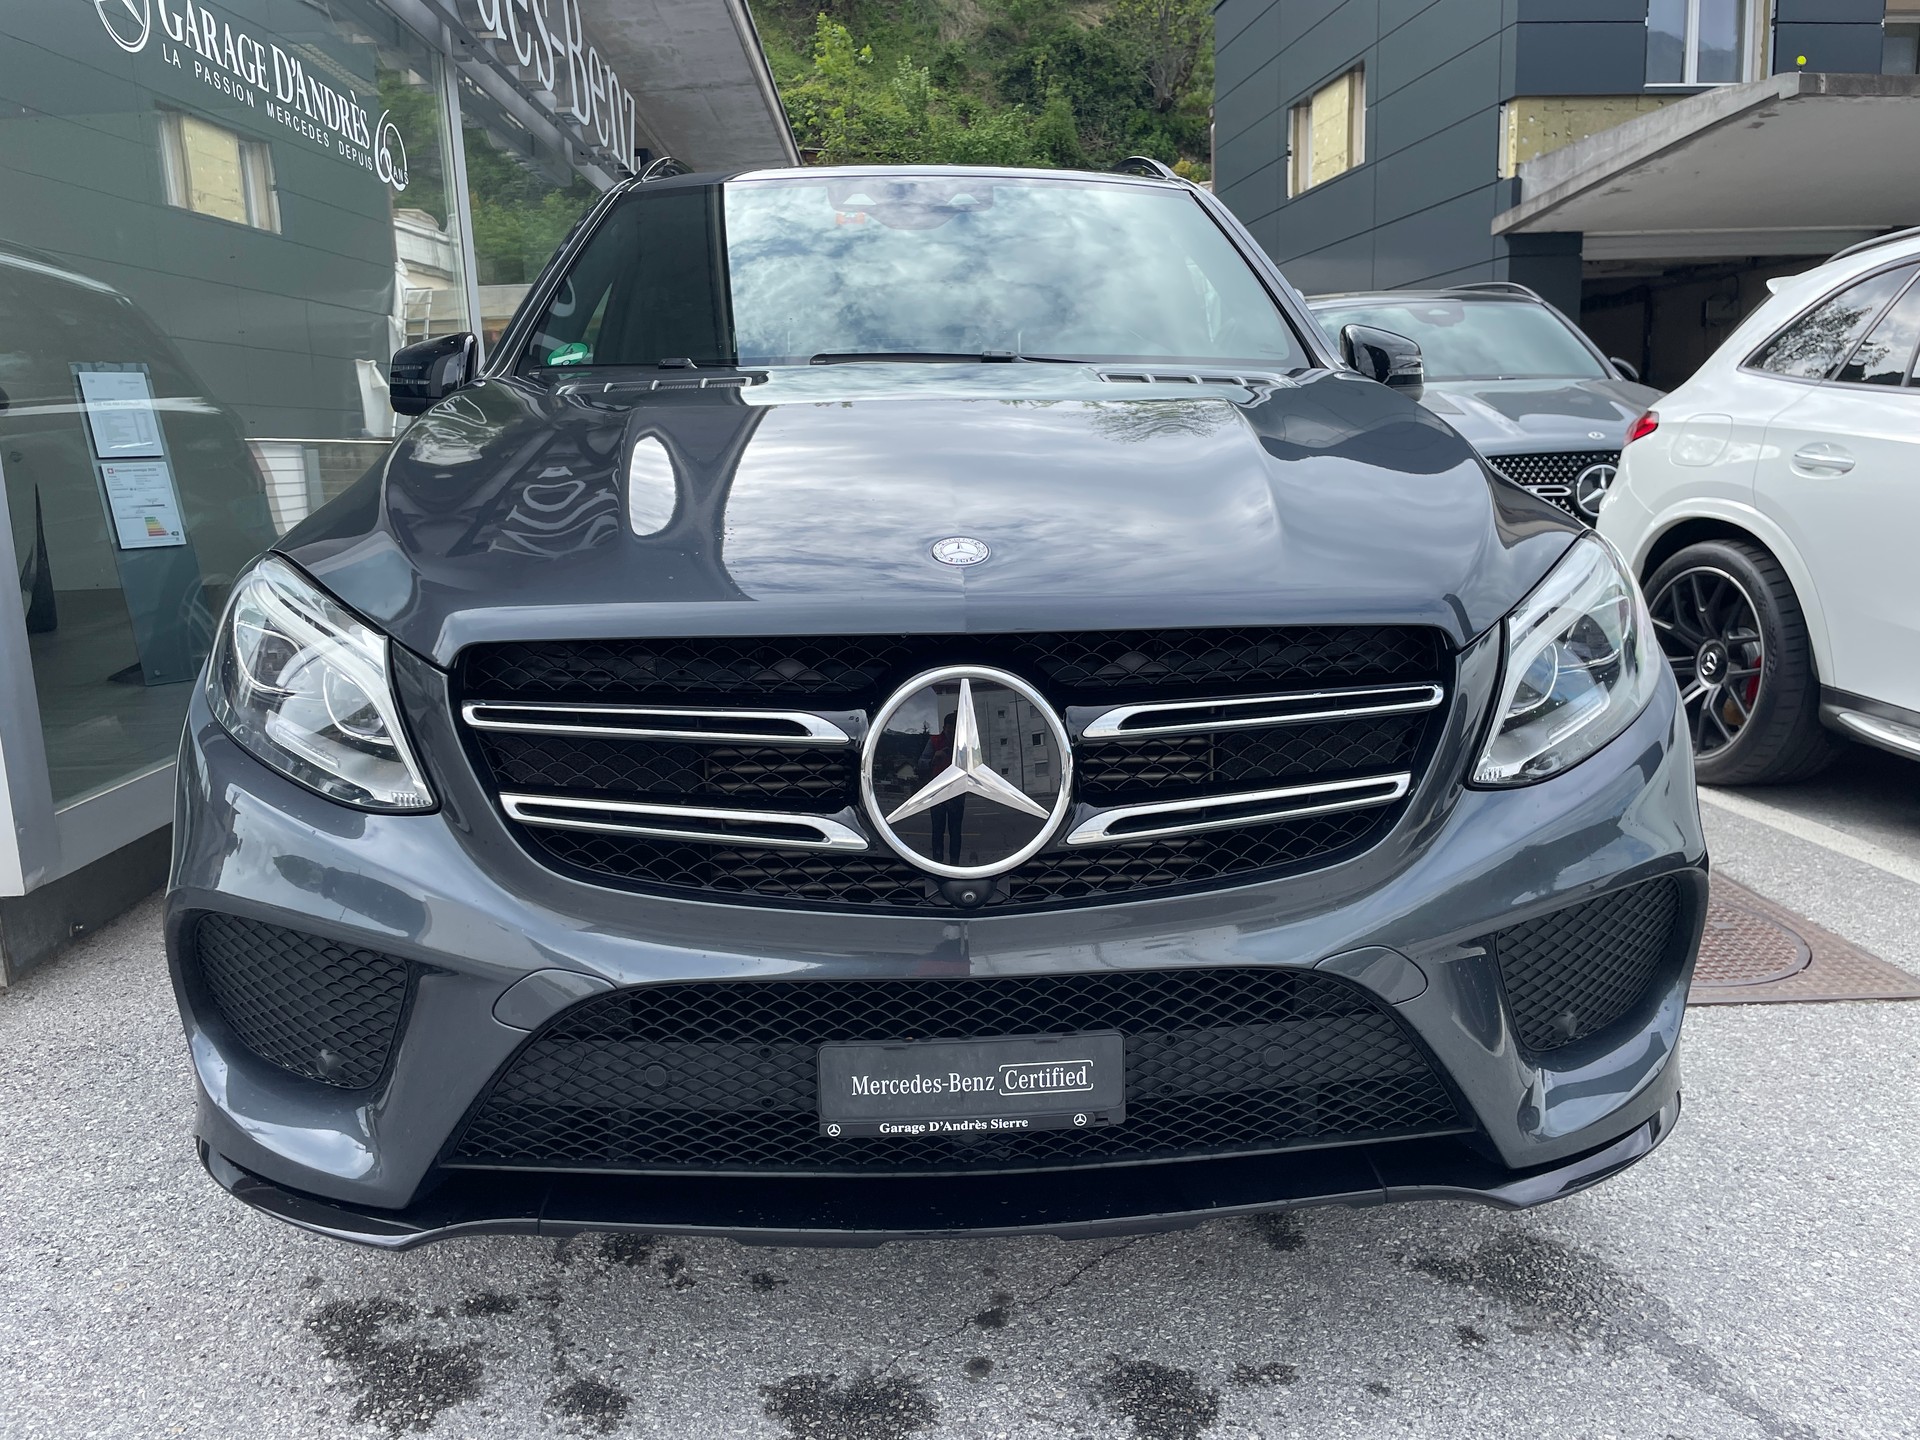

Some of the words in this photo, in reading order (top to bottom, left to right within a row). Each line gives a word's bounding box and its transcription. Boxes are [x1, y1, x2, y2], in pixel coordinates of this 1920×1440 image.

[157, 0, 270, 92] GARAGE
[270, 43, 371, 150] D'ANDRÈS
[162, 43, 182, 69] LA
[194, 60, 255, 108] PASSION
[266, 100, 330, 148] MERCEDES
[338, 140, 373, 171] DEPUIS
[393, 165, 409, 185] ANS
[477, 0, 641, 175] es-Benz
[851, 1072, 995, 1096] Mercedes-Benz
[1005, 1065, 1088, 1090] Certified
[879, 1122, 926, 1135] Garage
[928, 1119, 988, 1132] D'Andrès
[990, 1118, 1029, 1130] Sierre
